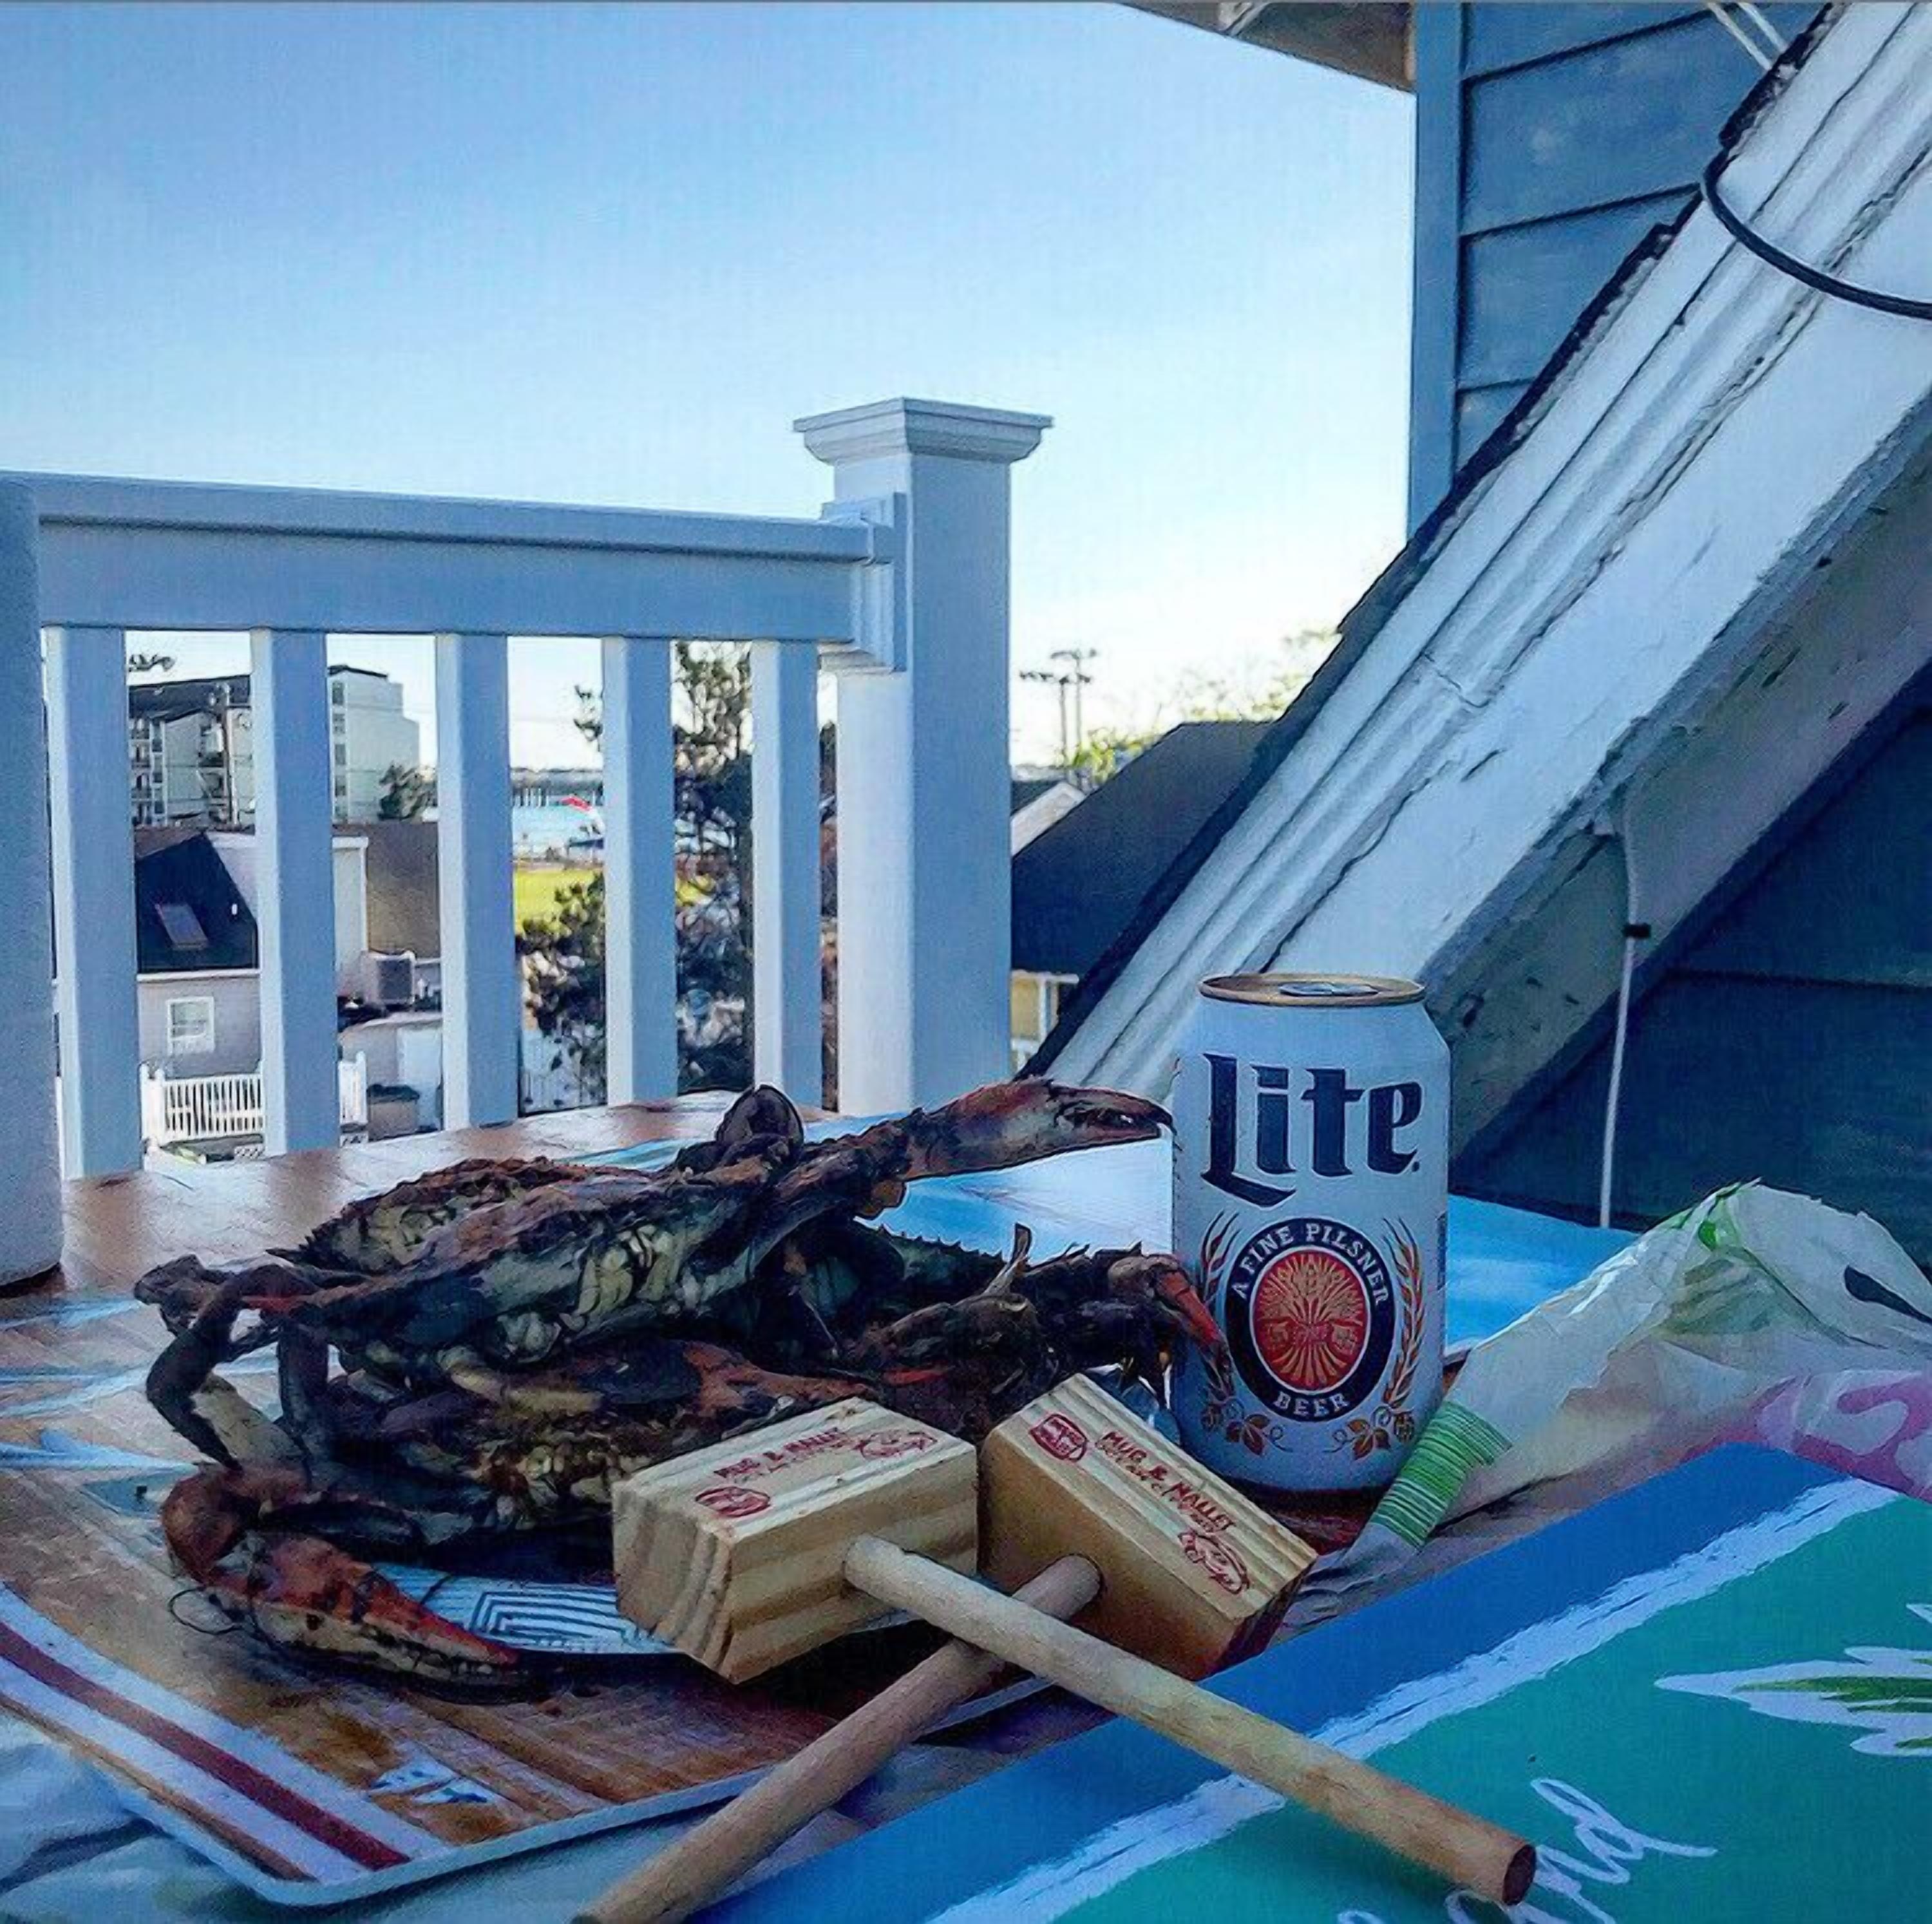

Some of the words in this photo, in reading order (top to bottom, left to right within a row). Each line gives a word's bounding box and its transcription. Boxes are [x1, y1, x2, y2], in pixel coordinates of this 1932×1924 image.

[1201, 1053, 1422, 1208] Lite
[1232, 1283, 1248, 1299] A
[1240, 1226, 1294, 1274] FINE
[1305, 1223, 1388, 1305] PILSNER
[1273, 1391, 1350, 1418] BEER
